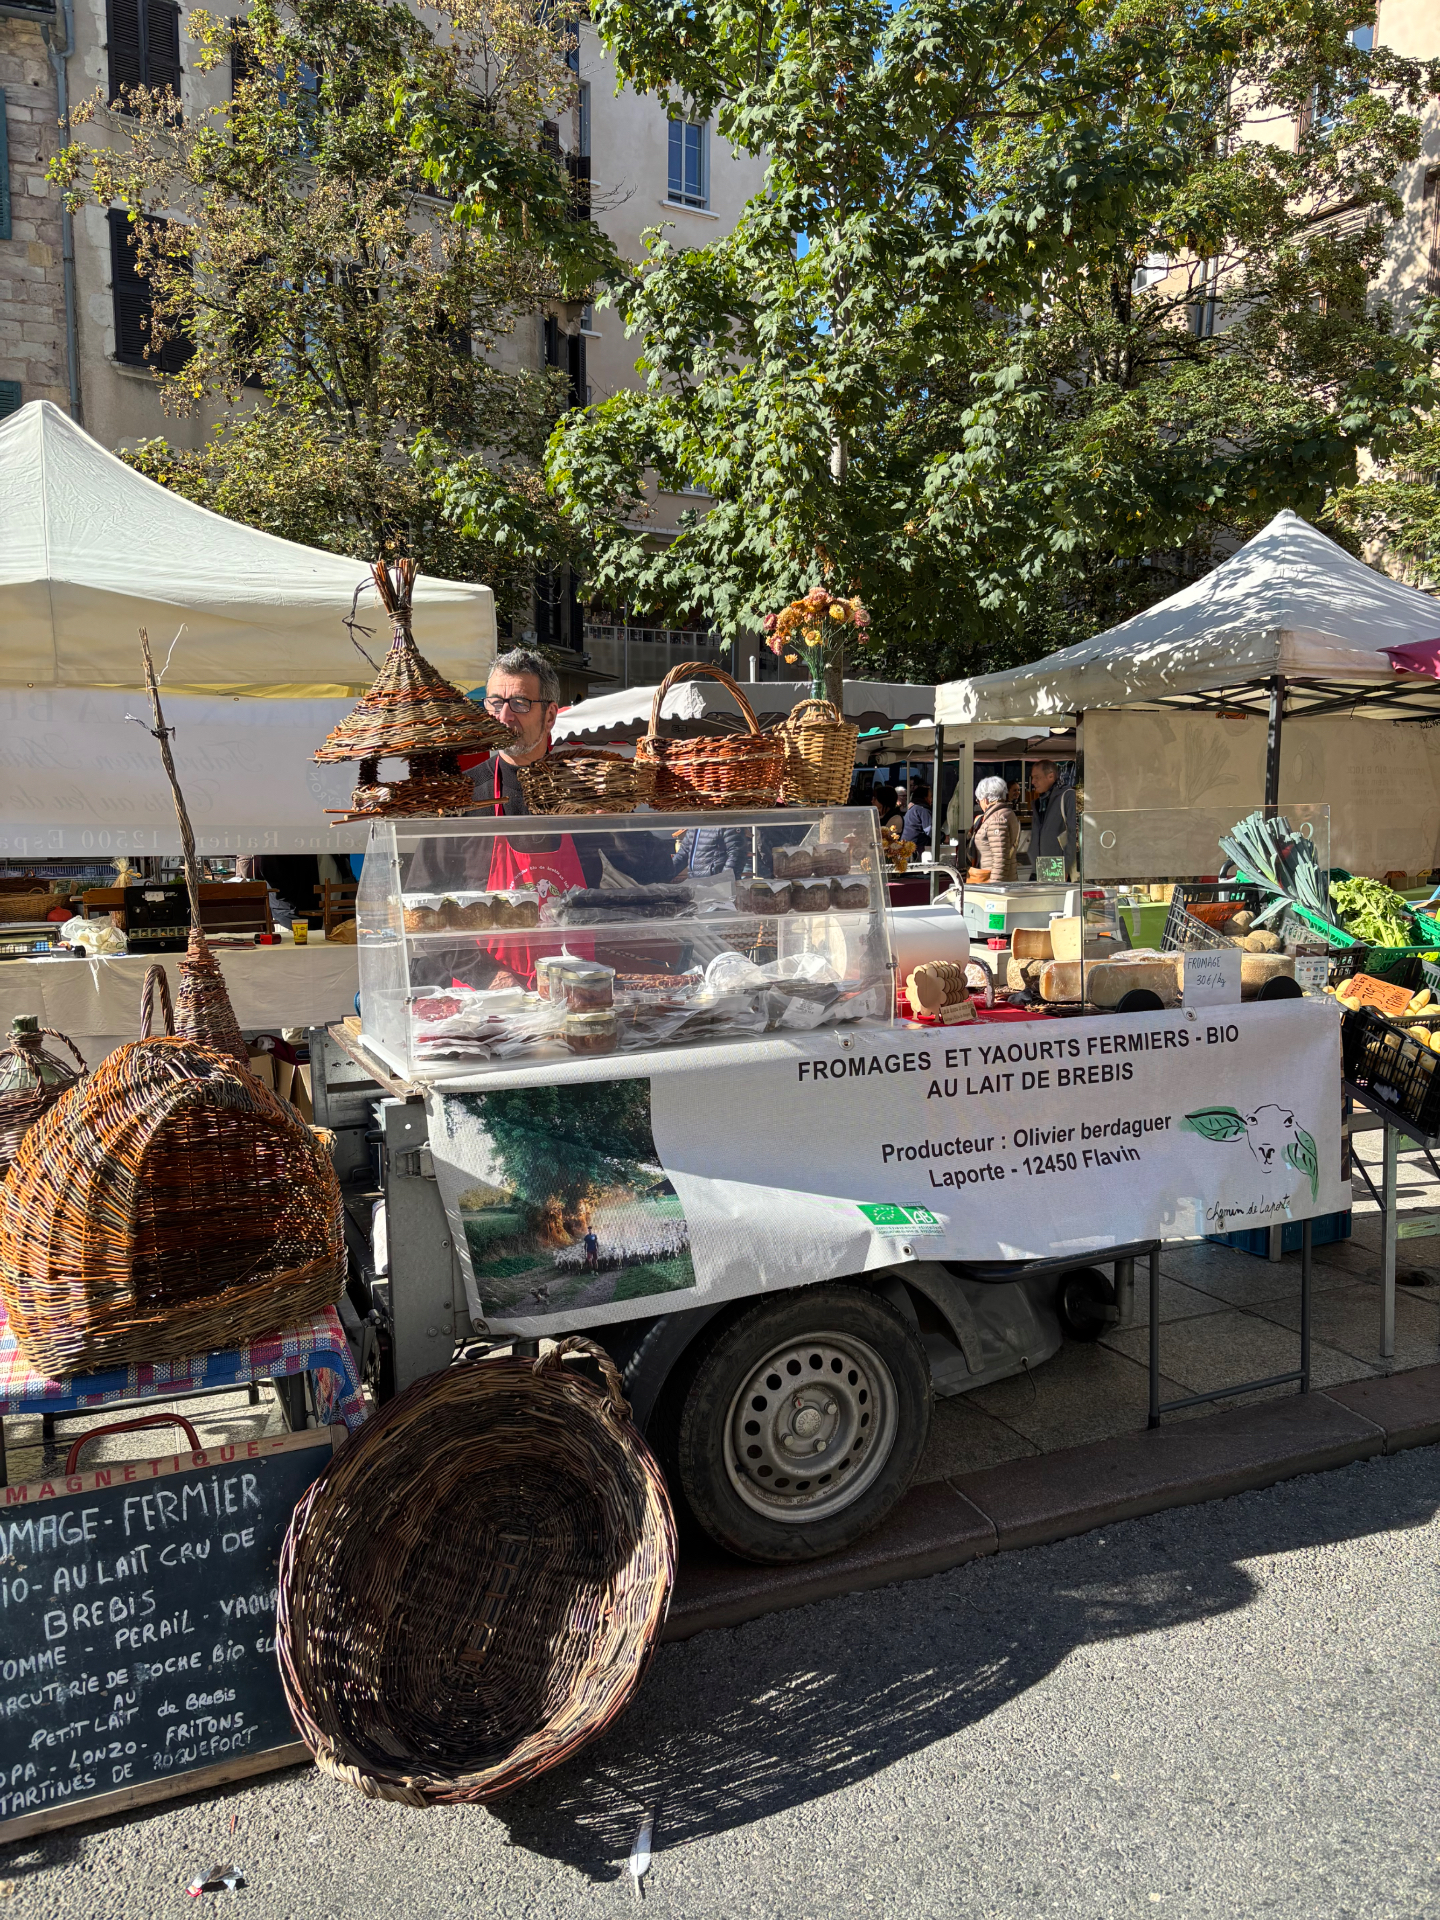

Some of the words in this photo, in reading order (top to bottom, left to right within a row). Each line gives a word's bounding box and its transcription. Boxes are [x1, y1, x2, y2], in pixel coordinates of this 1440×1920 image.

[1188, 956, 1221, 970] FROMAGE
[798, 1051, 931, 1082] FROMAGES
[945, 1047, 972, 1068] ET
[978, 1038, 1081, 1065] YAOURTS
[1087, 1029, 1190, 1056] FERMIERS
[1206, 1024, 1239, 1045] BIO
[927, 1078, 958, 1099] AU
[966, 1073, 1015, 1096] LAIT
[1022, 1070, 1050, 1090] DE
[1057, 1062, 1134, 1087] BREBIS
[881, 1135, 995, 1163] Producteur
[1013, 1126, 1076, 1148] Olivier
[1080, 1115, 1172, 1141] berdaguer
[928, 1162, 1005, 1190] Laporte
[1022, 1151, 1078, 1176] 12450
[1082, 1145, 1141, 1168] Flavin
[1246, 1202, 1257, 1215] de
[6, 1441, 260, 1504] MAGNETIQUE
[53, 1564, 87, 1594] AU
[159, 1538, 211, 1567] CRU
[222, 1527, 256, 1553] DE
[106, 1668, 129, 1689] DE
[113, 1691, 136, 1711] AU
[112, 1763, 135, 1783] DE
[153, 1725, 259, 1771] ROQUEFORT
